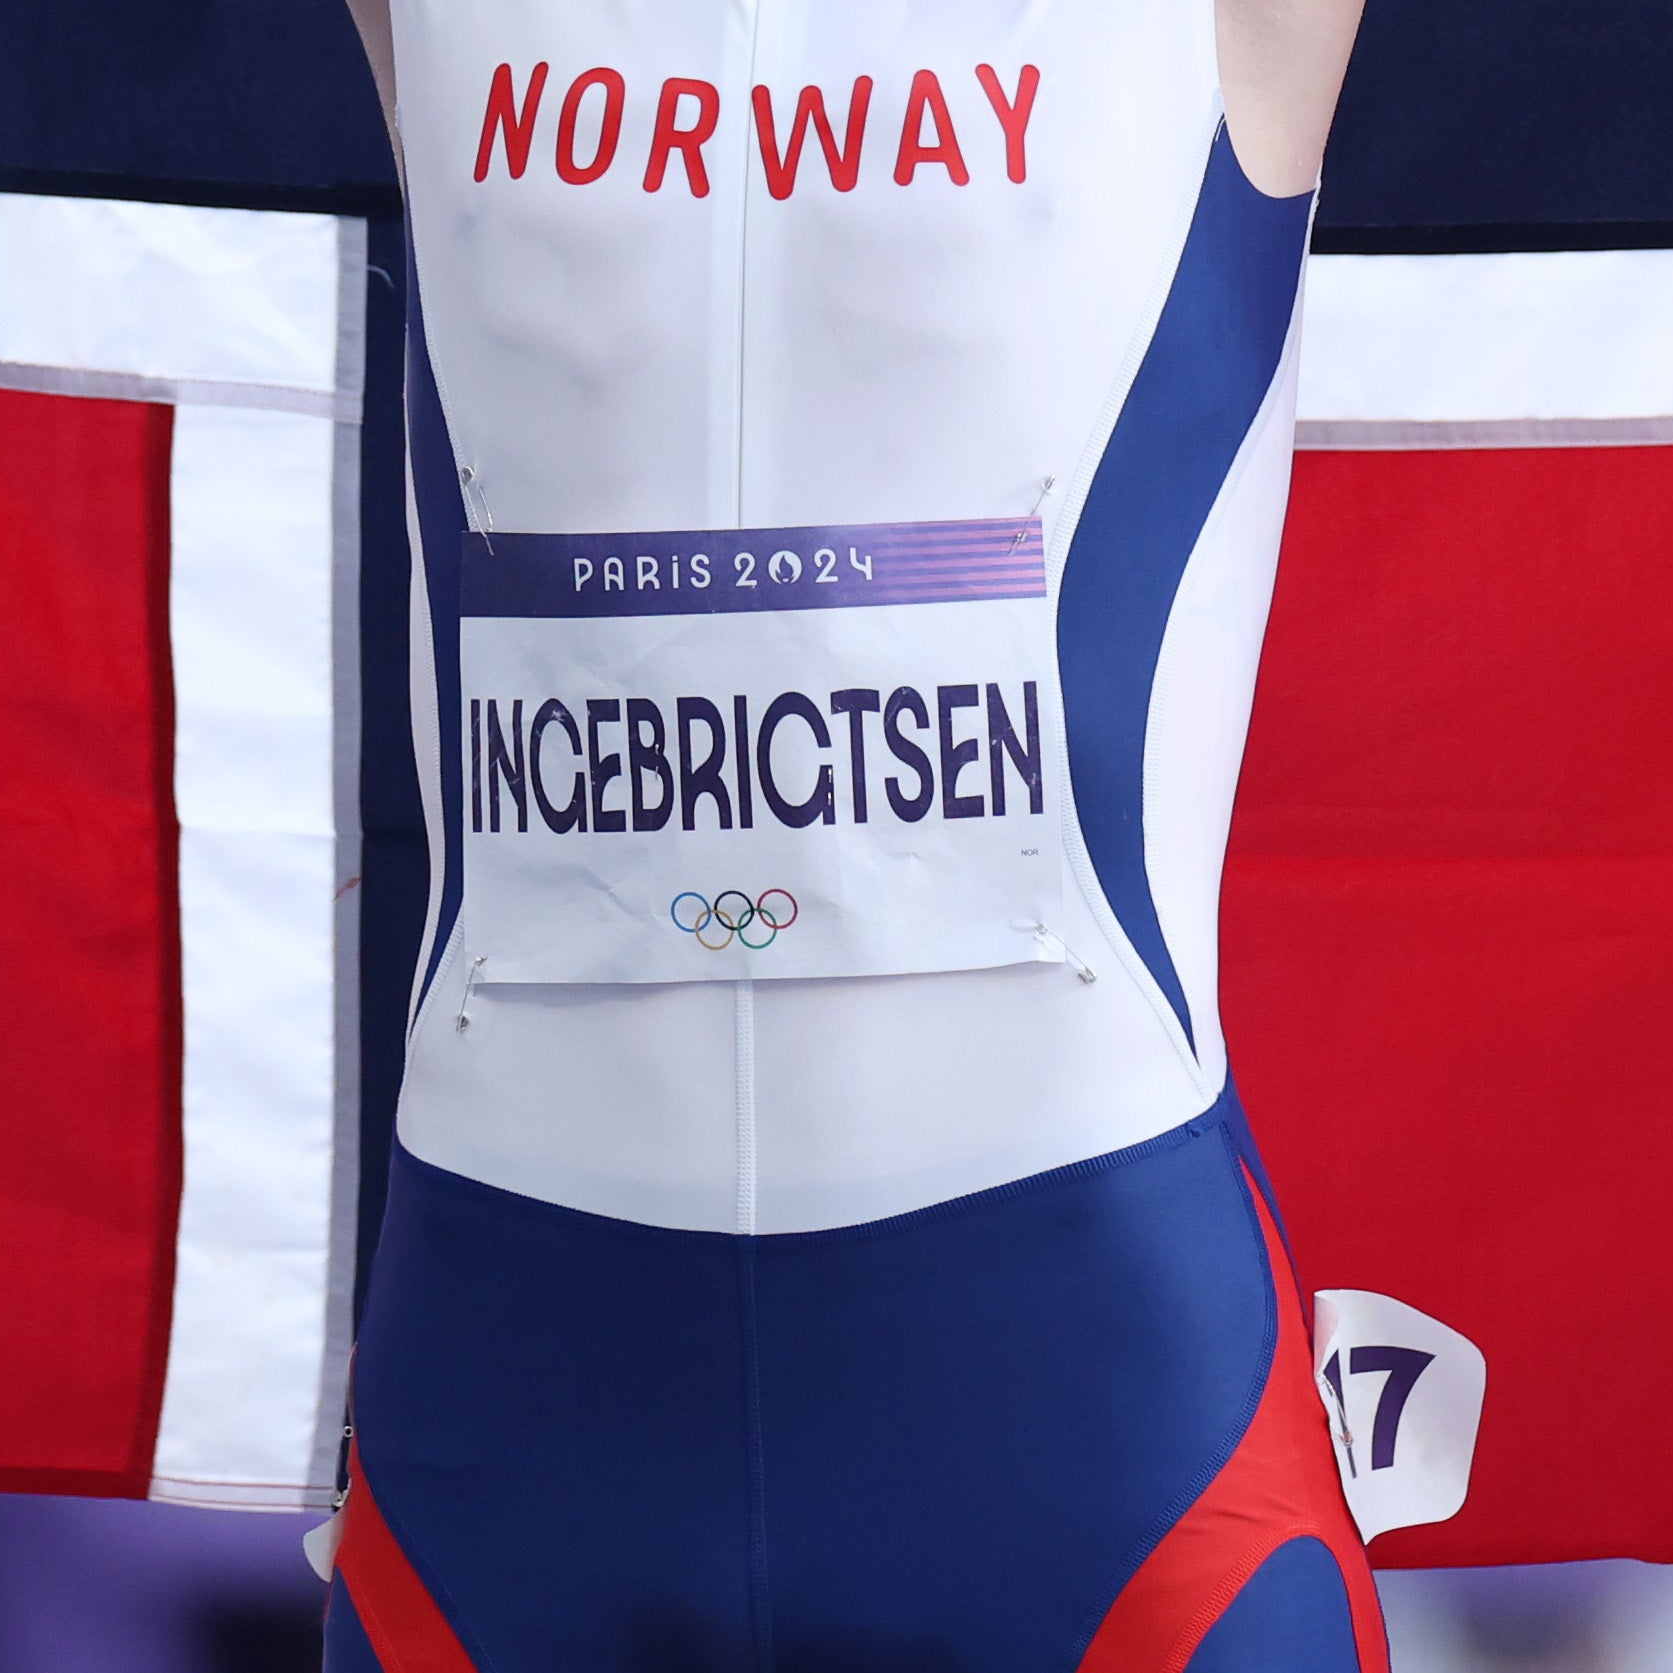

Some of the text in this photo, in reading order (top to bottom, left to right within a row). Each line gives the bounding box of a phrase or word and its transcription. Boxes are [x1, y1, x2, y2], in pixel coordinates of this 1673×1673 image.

[473, 60, 1040, 201] NORWAY
[734, 546, 874, 588] 2024
[470, 680, 1044, 835] INGEBRIGTSEN
[1020, 848, 1040, 857] NOR
